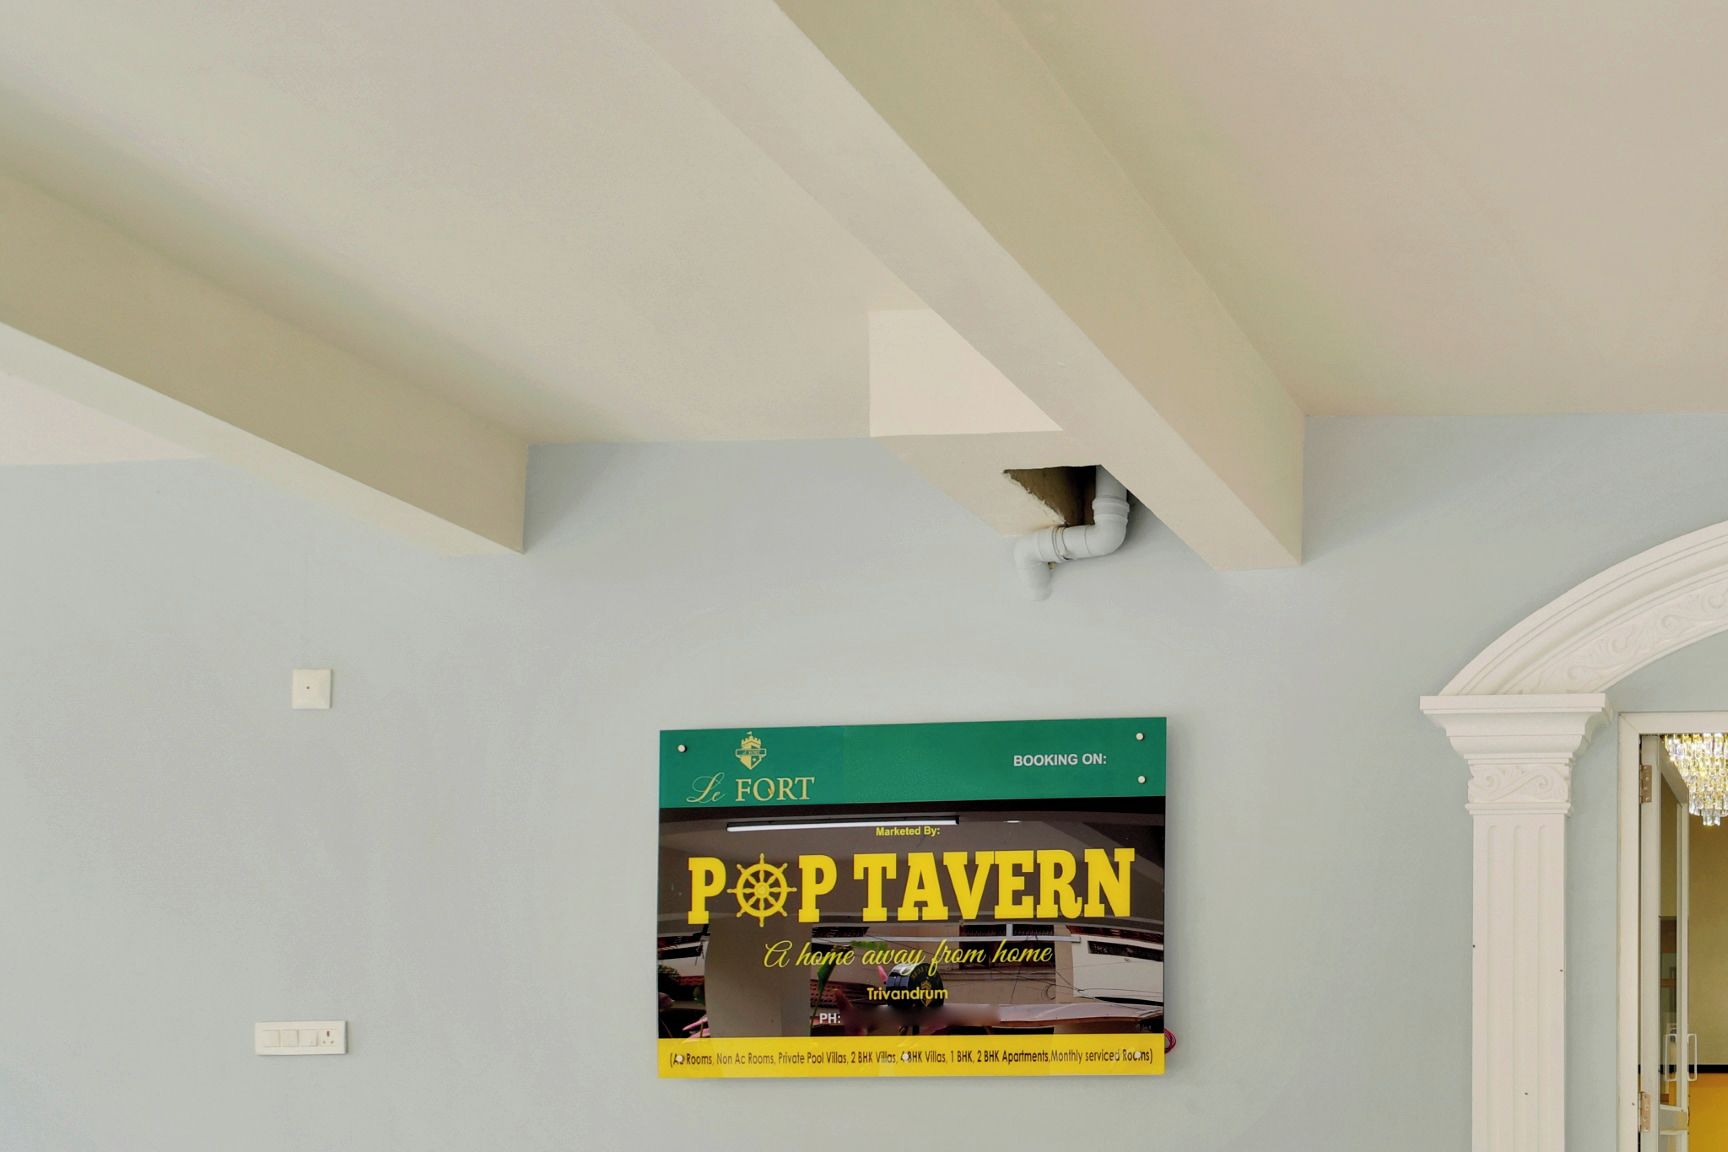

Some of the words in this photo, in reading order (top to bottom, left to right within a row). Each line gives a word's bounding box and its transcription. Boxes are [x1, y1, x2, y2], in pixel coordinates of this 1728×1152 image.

[1013, 753, 1079, 767] BOOKING
[1081, 752, 1107, 765] ON:
[686, 771, 726, 804] Le
[735, 776, 815, 802] FORT
[875, 826, 922, 837] Marketed
[923, 825, 941, 837] By:
[853, 847, 1136, 922] TAVERN
[763, 939, 792, 968] A
[795, 941, 855, 967] home
[861, 948, 926, 976] away
[929, 938, 991, 976] from
[992, 938, 1054, 963] home
[866, 986, 949, 1001] Trivandrum
[819, 1013, 842, 1025] PH:
[686, 1053, 714, 1065] Rooms,
[716, 1053, 733, 1065] Non
[735, 1053, 746, 1064] Ac
[748, 1052, 775, 1065] Rooms,
[778, 1051, 805, 1064] Private
[807, 1051, 824, 1064] Pool
[826, 1051, 849, 1064] Villas,
[851, 1051, 856, 1063] 2
[858, 1051, 873, 1063] BHK
[925, 1050, 948, 1064] Villas,
[957, 1050, 974, 1063] BHK,
[977, 1050, 983, 1062] 2
[984, 1050, 999, 1062] BHK
[1085, 1049, 1120, 1061] serviced
